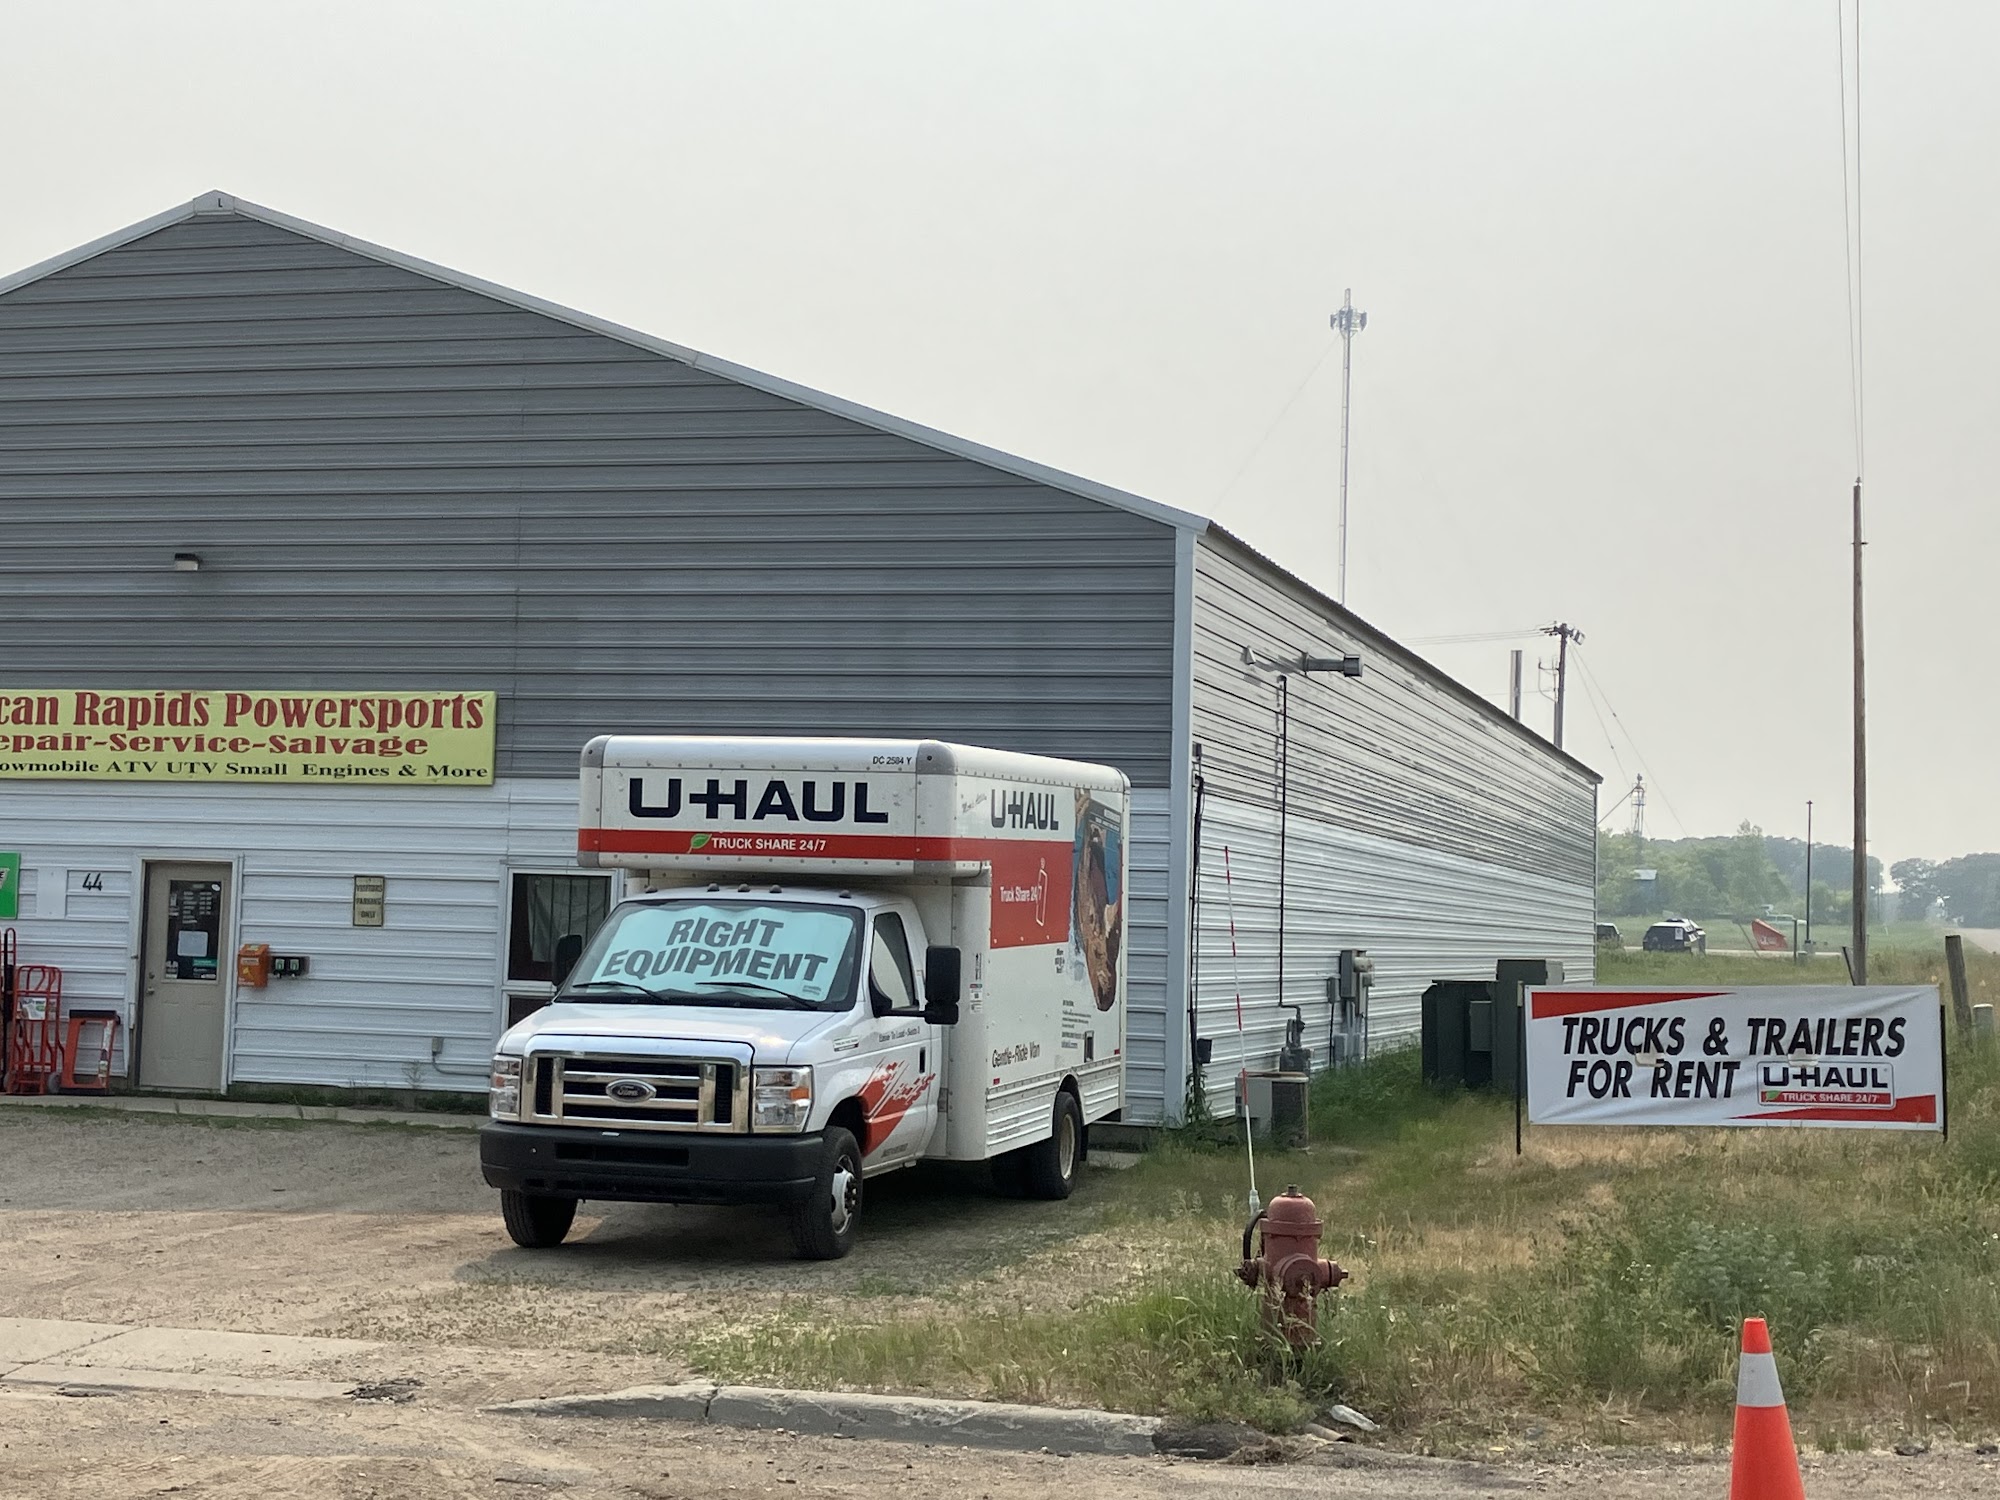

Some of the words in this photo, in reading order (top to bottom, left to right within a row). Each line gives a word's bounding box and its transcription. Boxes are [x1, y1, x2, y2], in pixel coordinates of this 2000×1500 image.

[73, 691, 210, 731] Rapids
[224, 692, 485, 733] Powersports
[0, 760, 99, 772] owmobile
[106, 761, 158, 773] ATV
[167, 762, 218, 774] UTV
[226, 763, 288, 775] Small
[302, 764, 390, 778] Engines
[398, 764, 418, 777] &
[427, 765, 488, 778] More
[872, 755, 885, 765] DC
[906, 756, 913, 765] Y
[629, 777, 889, 823] U-HAUL
[990, 788, 1059, 831] U-HAUL
[711, 837, 753, 849] TRUCK
[755, 838, 796, 850] SHARE
[799, 839, 826, 852] 24/7
[82, 872, 103, 891] 44
[665, 917, 785, 948] RIGHT
[601, 946, 829, 981] EQUIPMENT
[1562, 1016, 1686, 1056] TRUCKS
[1702, 1017, 1730, 1056] &
[1747, 1017, 1907, 1058] TRAILERS
[1566, 1059, 1633, 1099] FOR
[1650, 1059, 1741, 1099] RENT
[1763, 1066, 1889, 1088] U-HAUL
[1781, 1092, 1817, 1102] TRUCK
[1819, 1093, 1853, 1103] SHARE
[1855, 1094, 1879, 1103] 24/7
